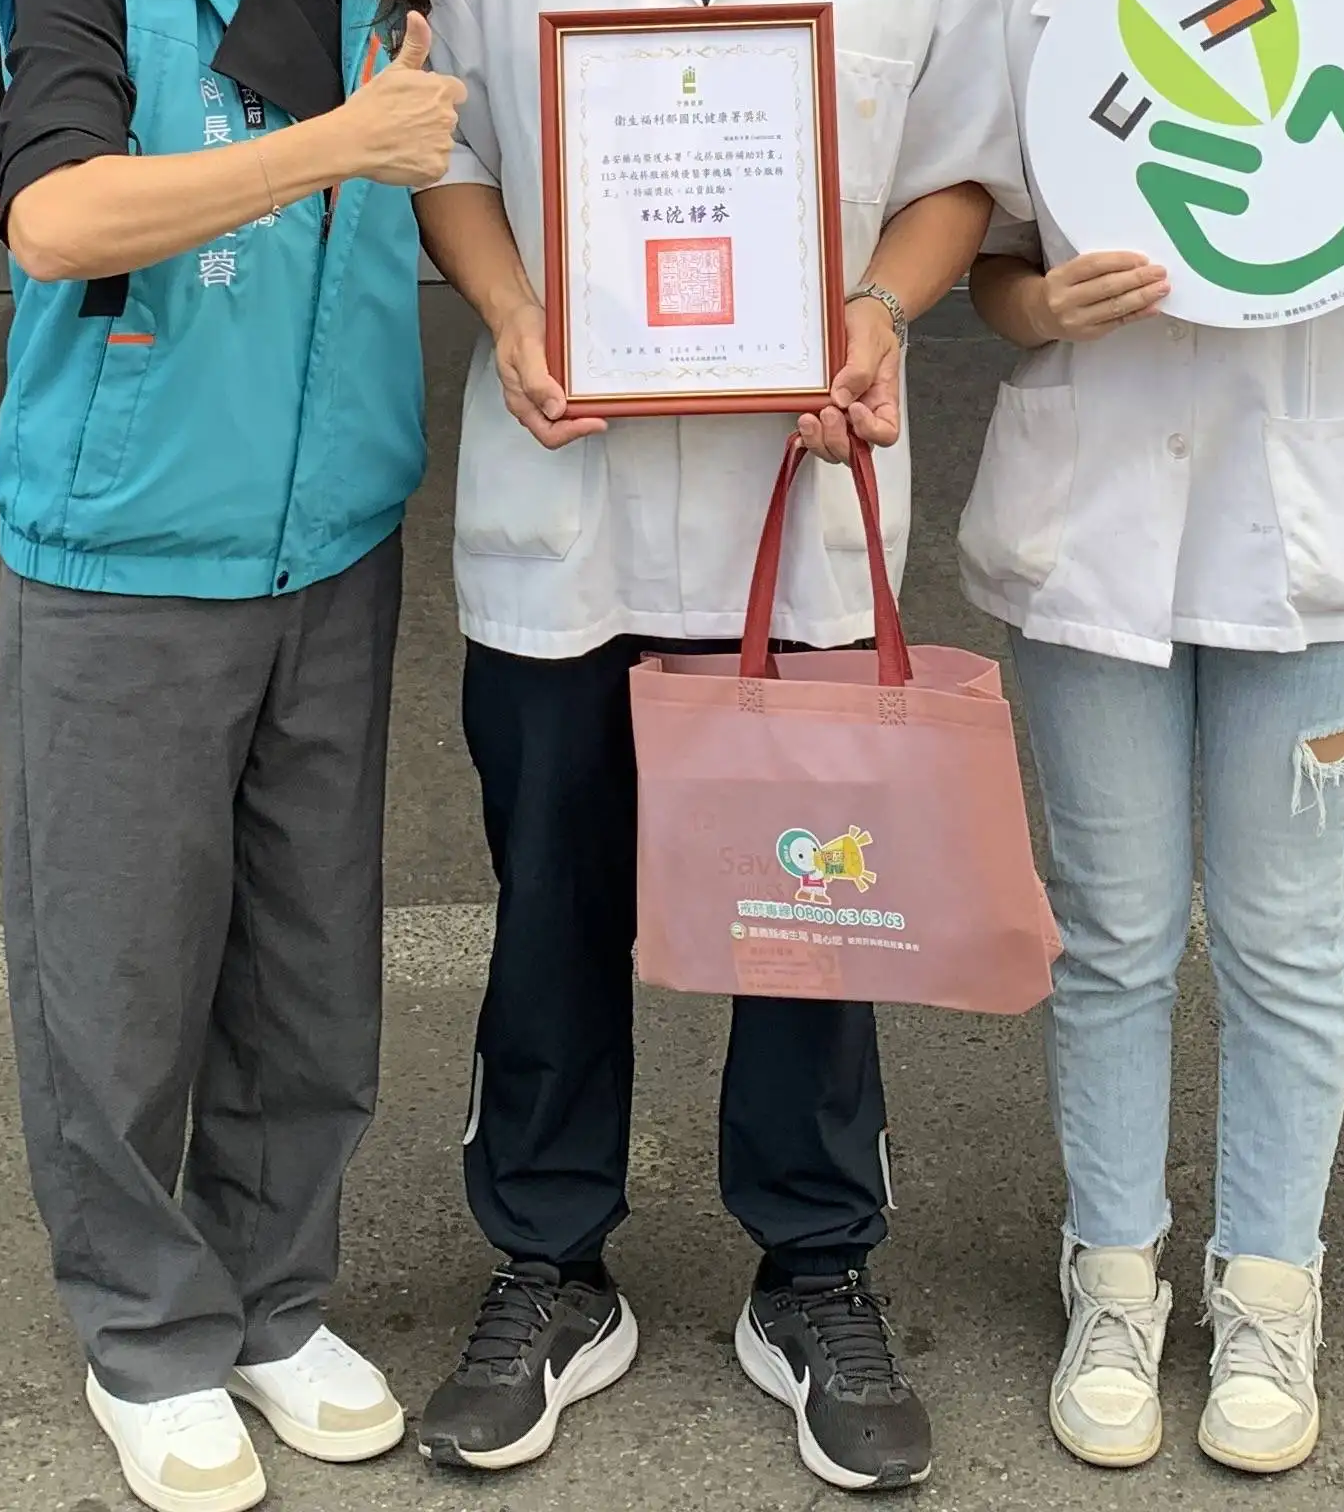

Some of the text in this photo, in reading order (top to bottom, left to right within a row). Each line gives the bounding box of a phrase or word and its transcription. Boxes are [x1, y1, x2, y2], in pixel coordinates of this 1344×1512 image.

[794, 904, 835, 924] 0800
[837, 909, 859, 925] 63
[861, 910, 883, 927] 63
[884, 912, 905, 930] 63
